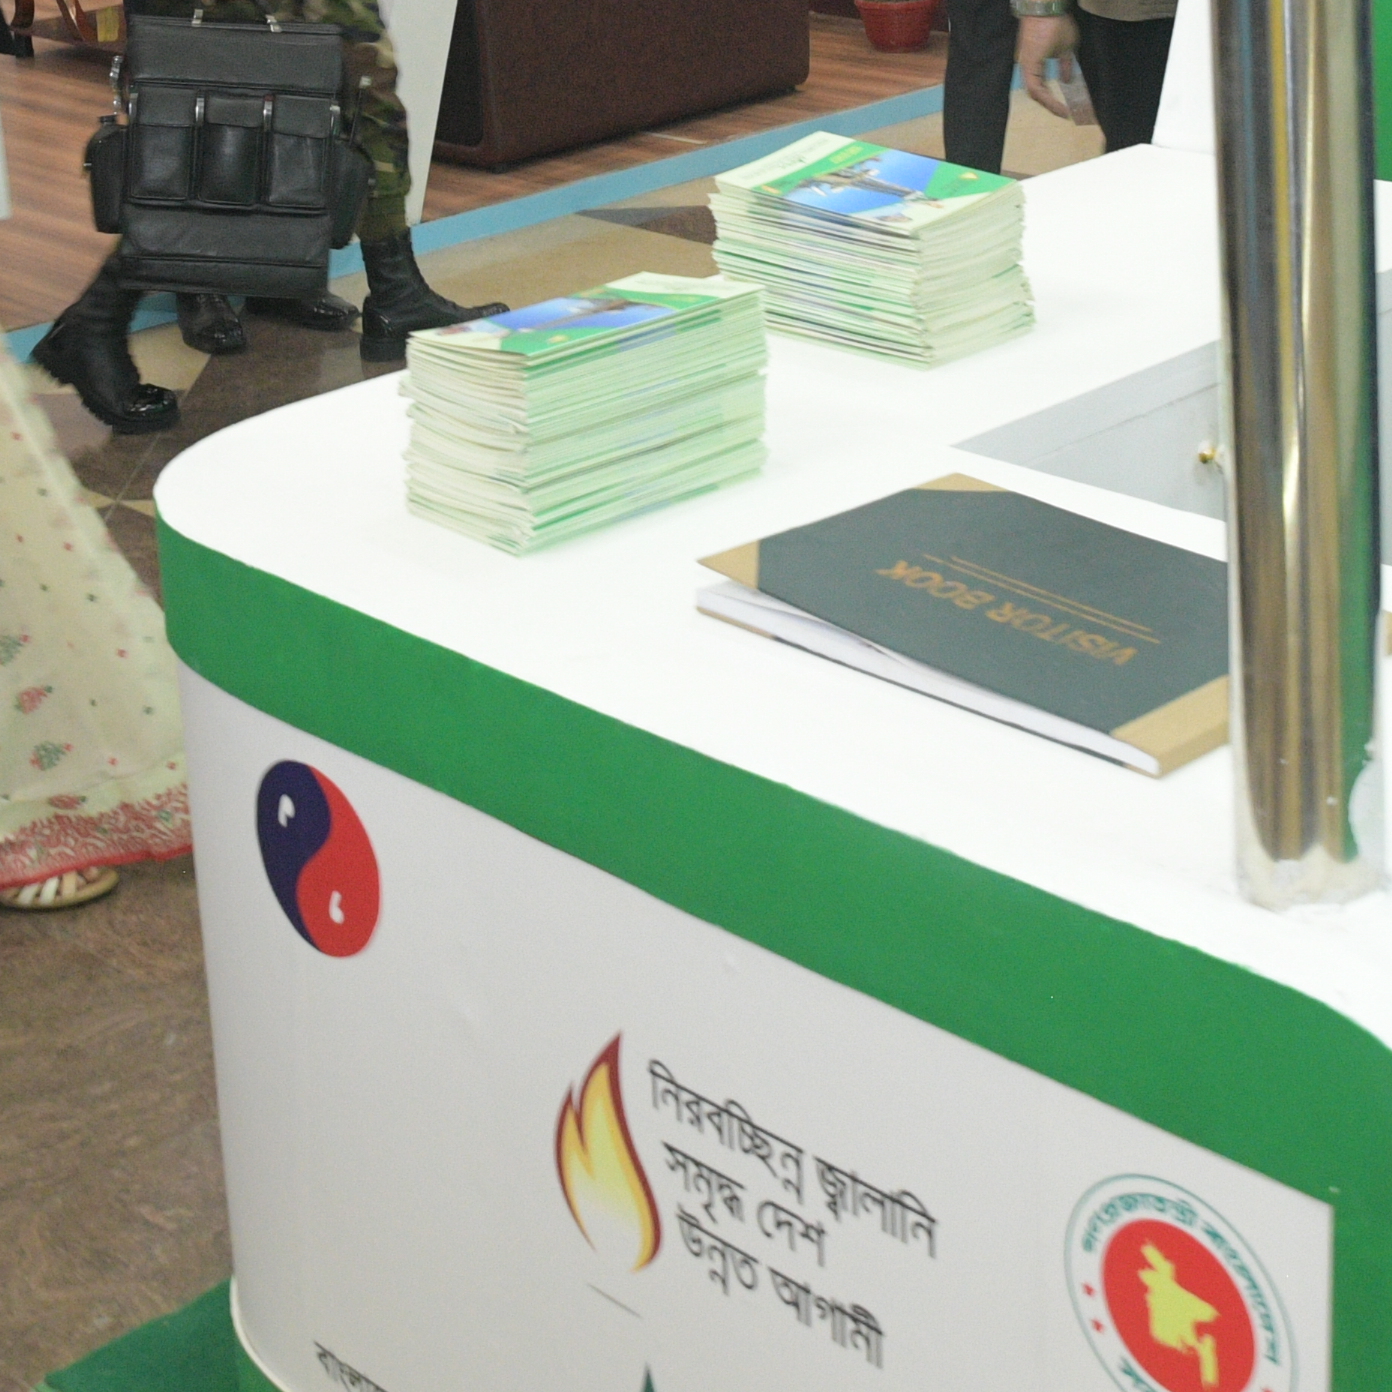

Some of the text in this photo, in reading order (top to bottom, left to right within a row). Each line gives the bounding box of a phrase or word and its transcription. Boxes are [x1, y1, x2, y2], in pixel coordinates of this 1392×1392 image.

[875, 560, 1139, 666] VISITOR BOOK
[648, 1058, 938, 1260] নিরবচ্ছিন্ন জ্বালানি
[661, 1141, 827, 1268] সমৃদ্ধ দেশ
[675, 1203, 885, 1370] উন্নত আগামী
